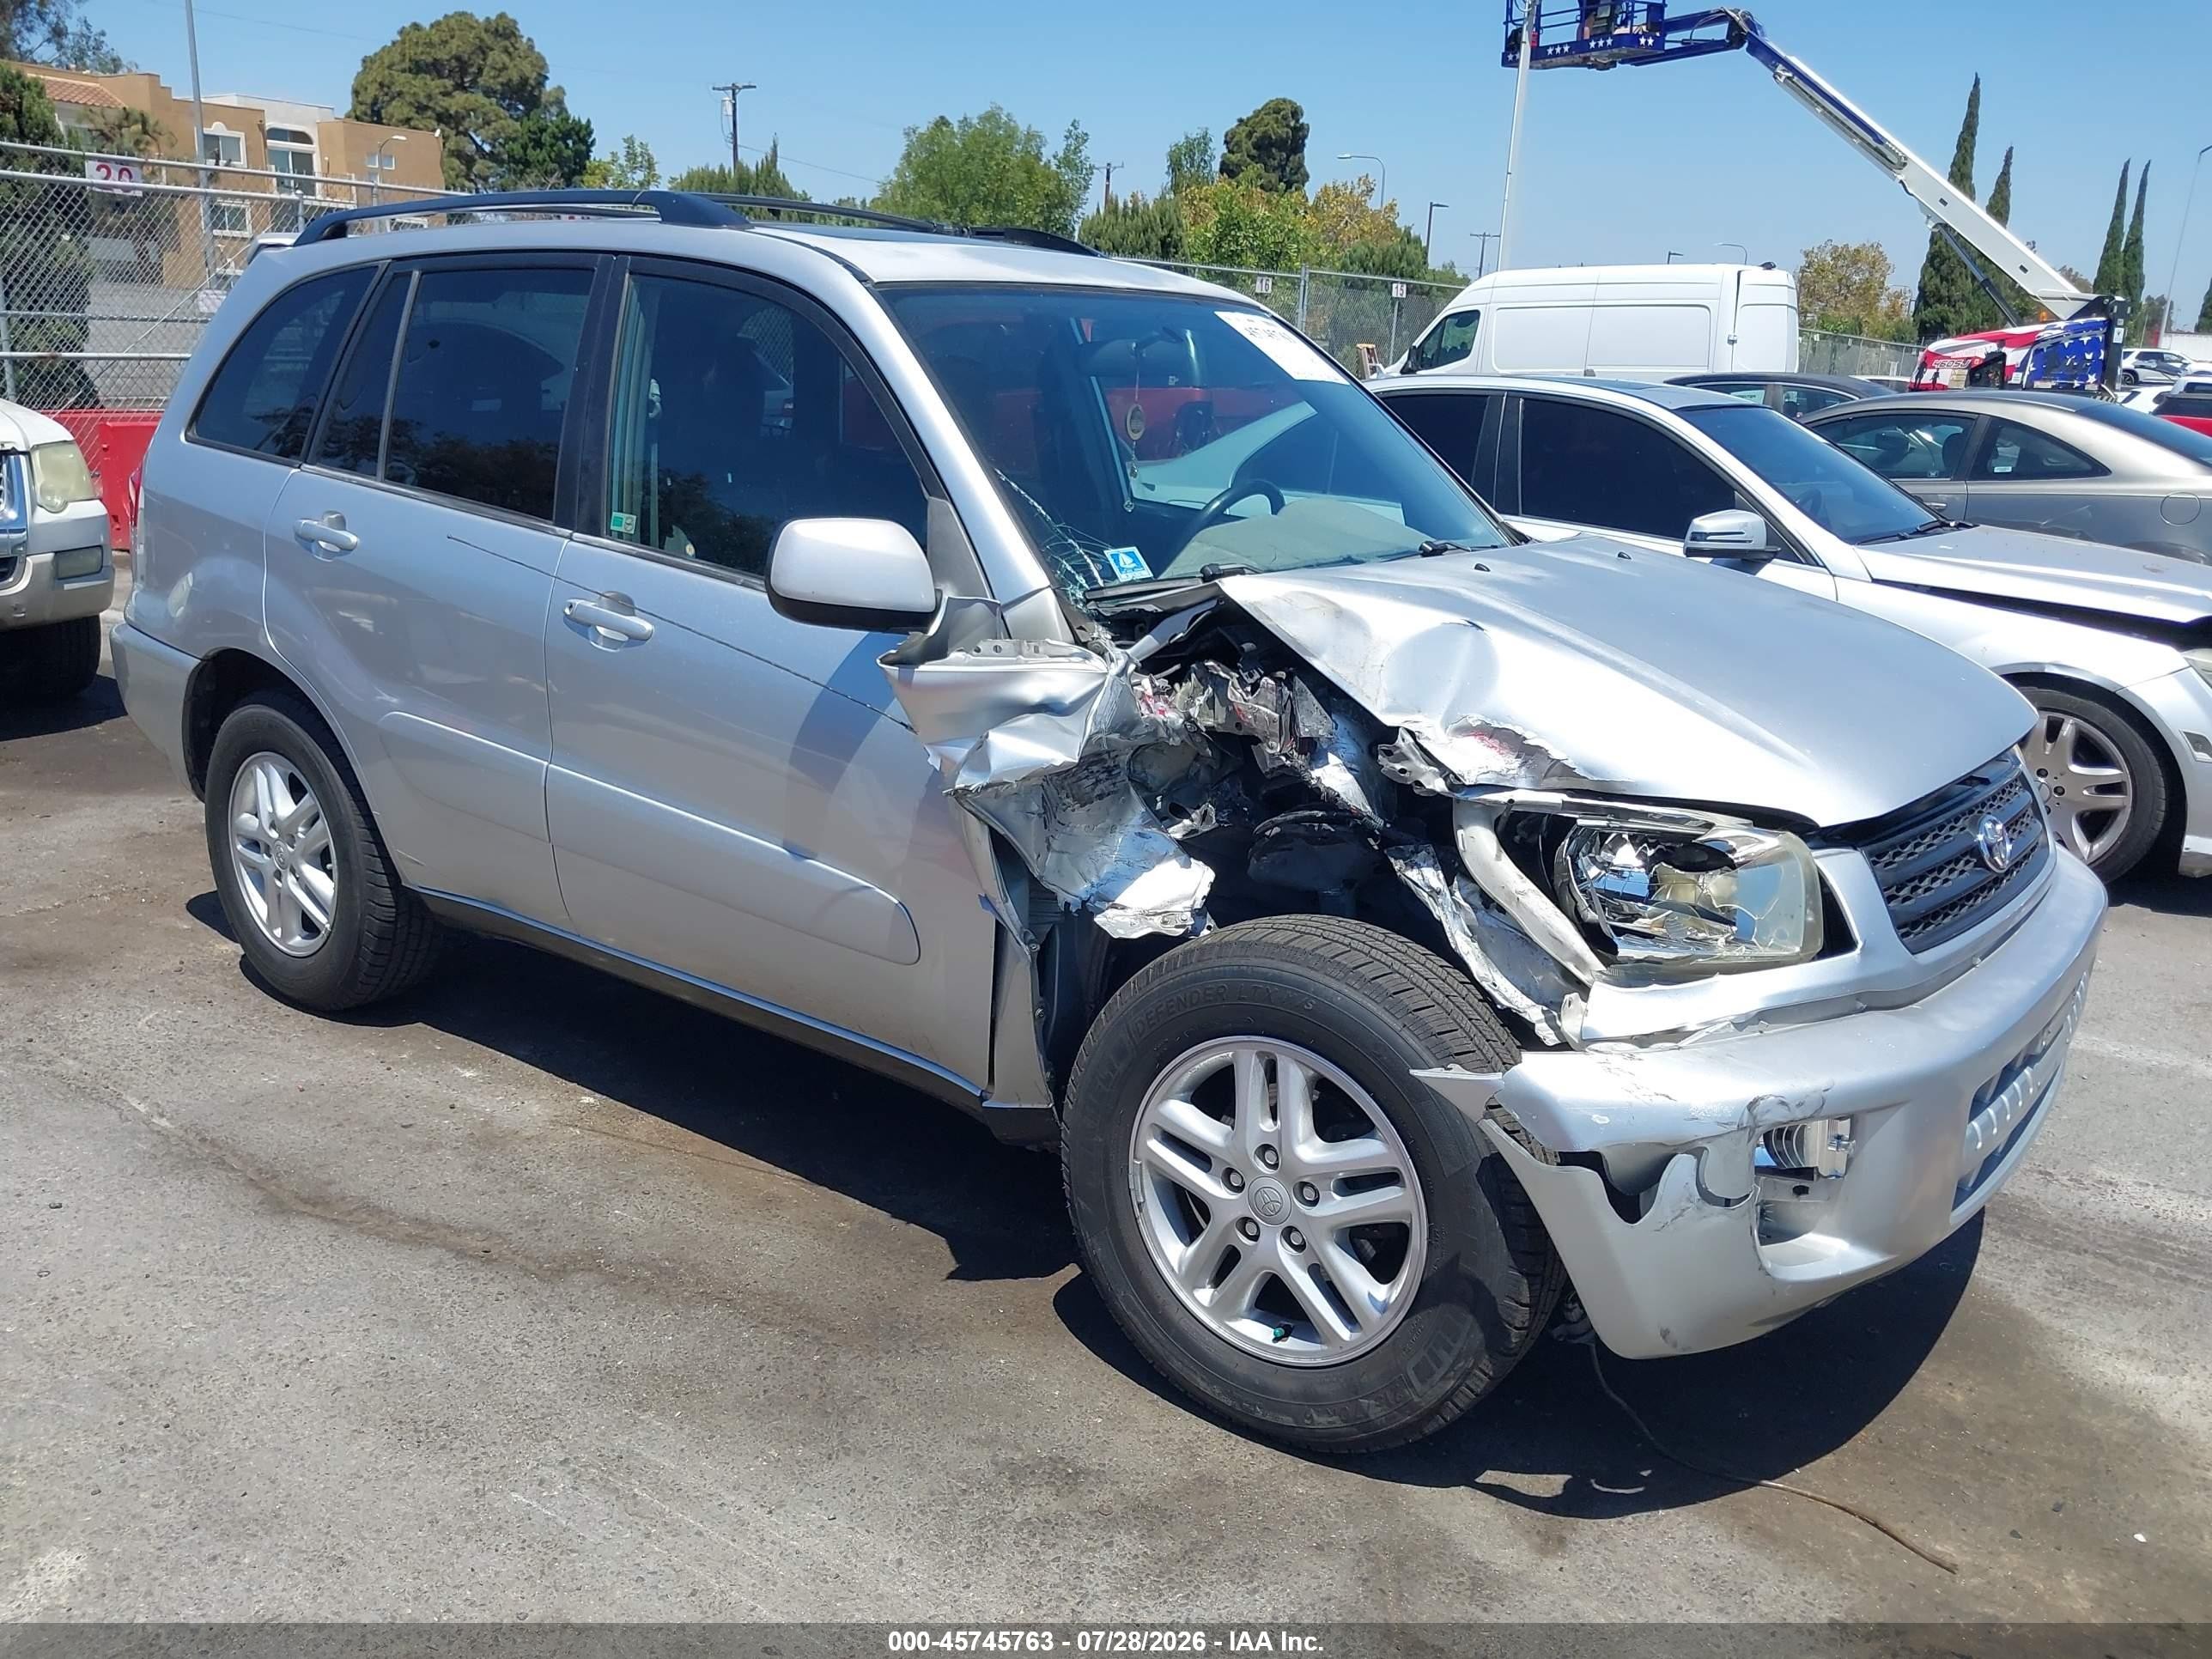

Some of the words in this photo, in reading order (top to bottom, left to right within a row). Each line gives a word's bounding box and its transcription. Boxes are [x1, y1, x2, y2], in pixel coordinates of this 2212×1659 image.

[1259, 278, 1270, 293] 16
[1395, 284, 1405, 296] 15
[1134, 984, 1229, 1038] DEFENDER
[1237, 985, 1279, 1005] LTX
